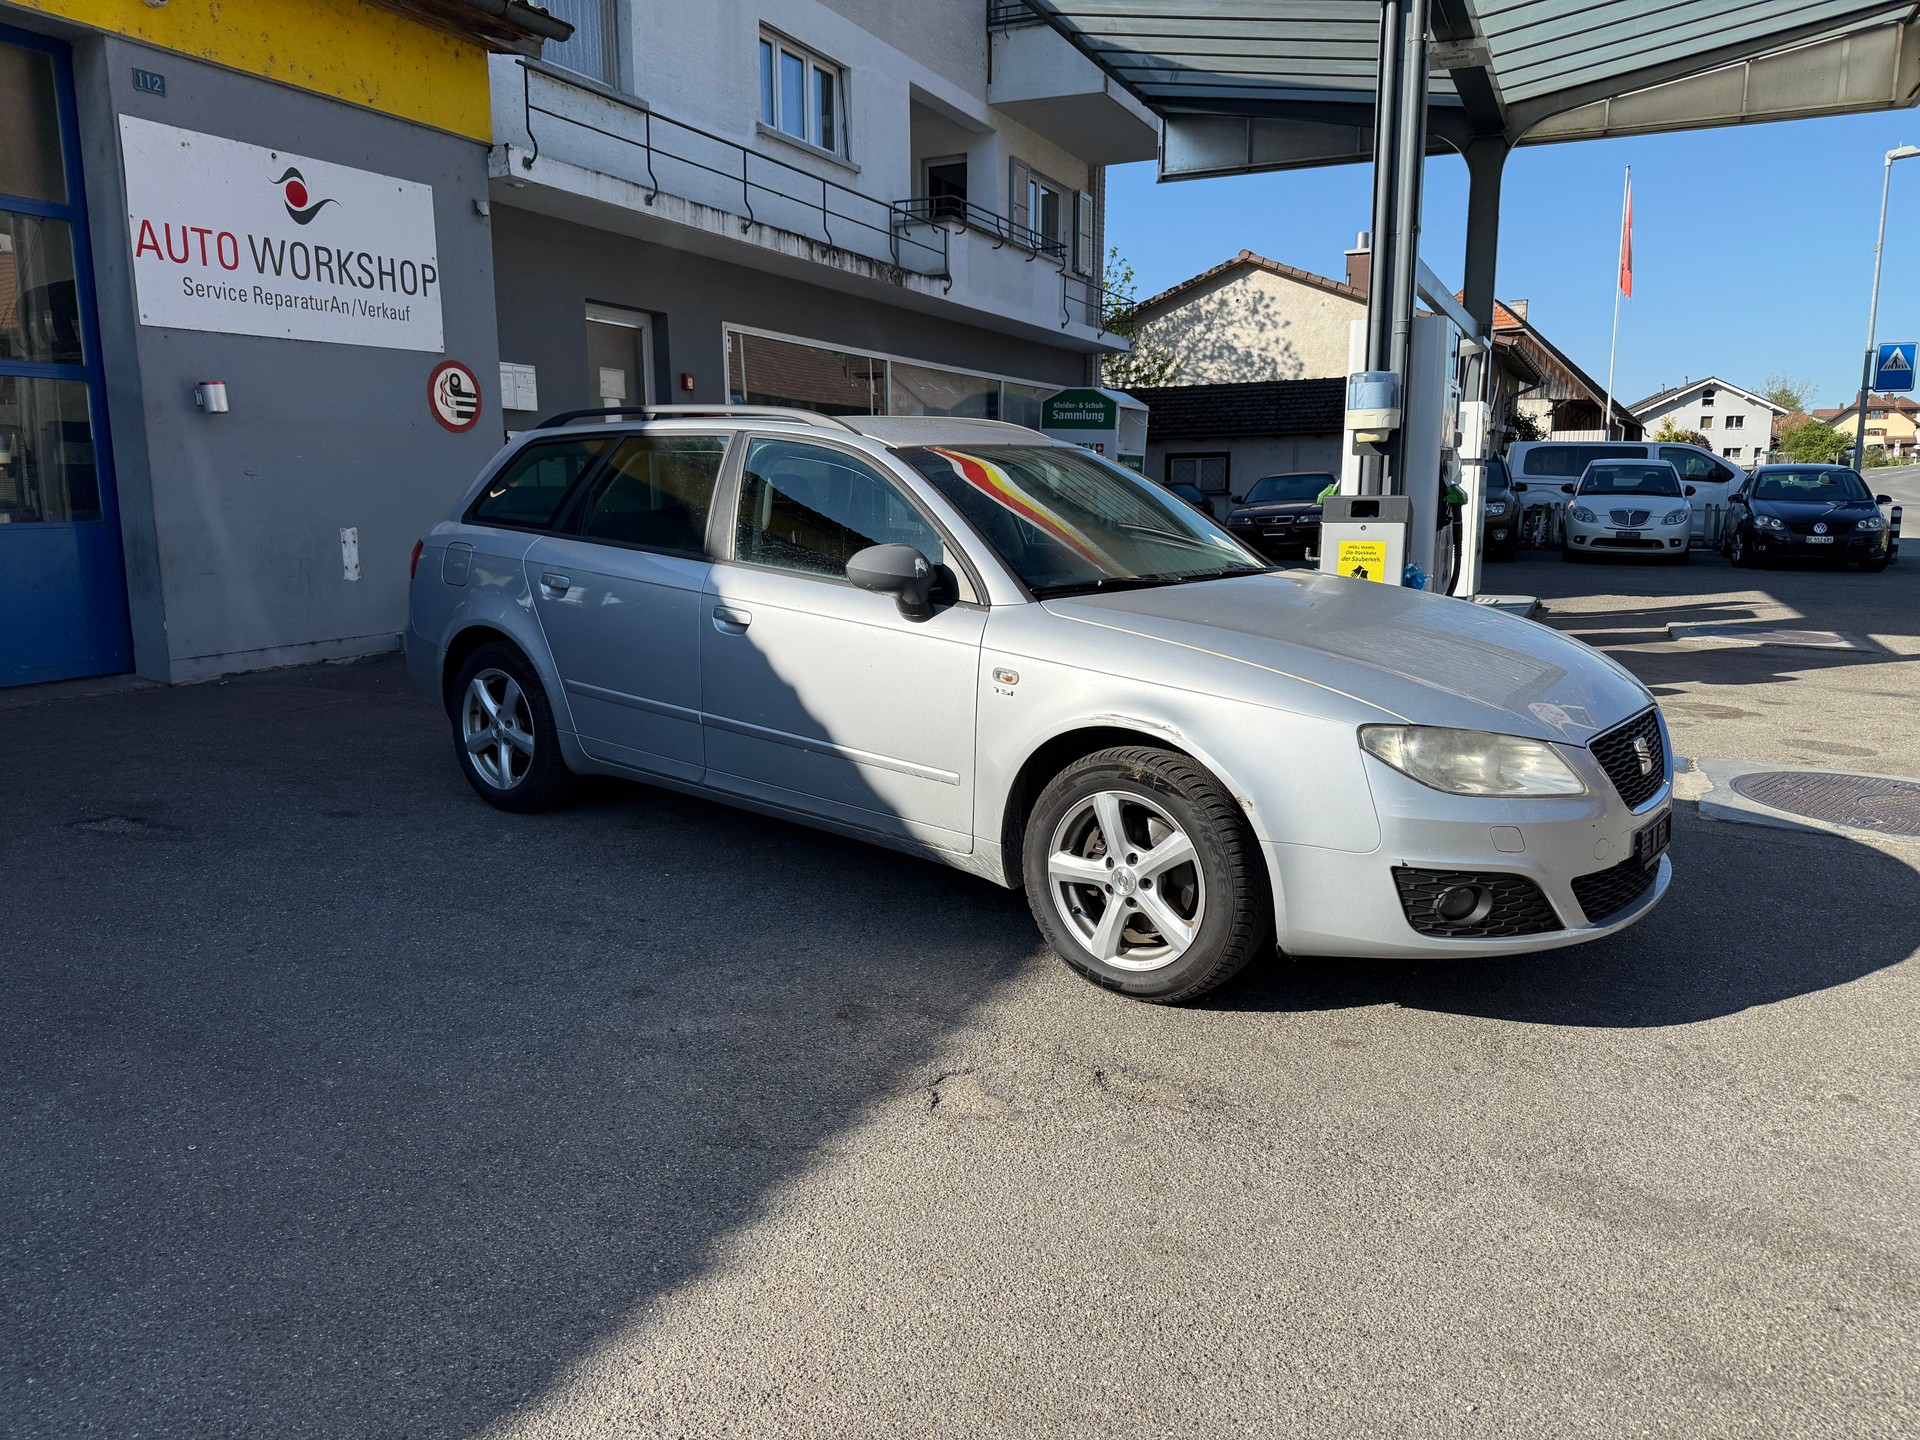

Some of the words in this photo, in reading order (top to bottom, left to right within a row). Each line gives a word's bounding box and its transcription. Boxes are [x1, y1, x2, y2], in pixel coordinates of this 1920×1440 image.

[137, 72, 162, 92] 112
[135, 219, 239, 271] AUTO
[247, 234, 437, 297] WORKSHOP
[182, 276, 248, 303] Service
[1052, 410, 1105, 423] Sammlung
